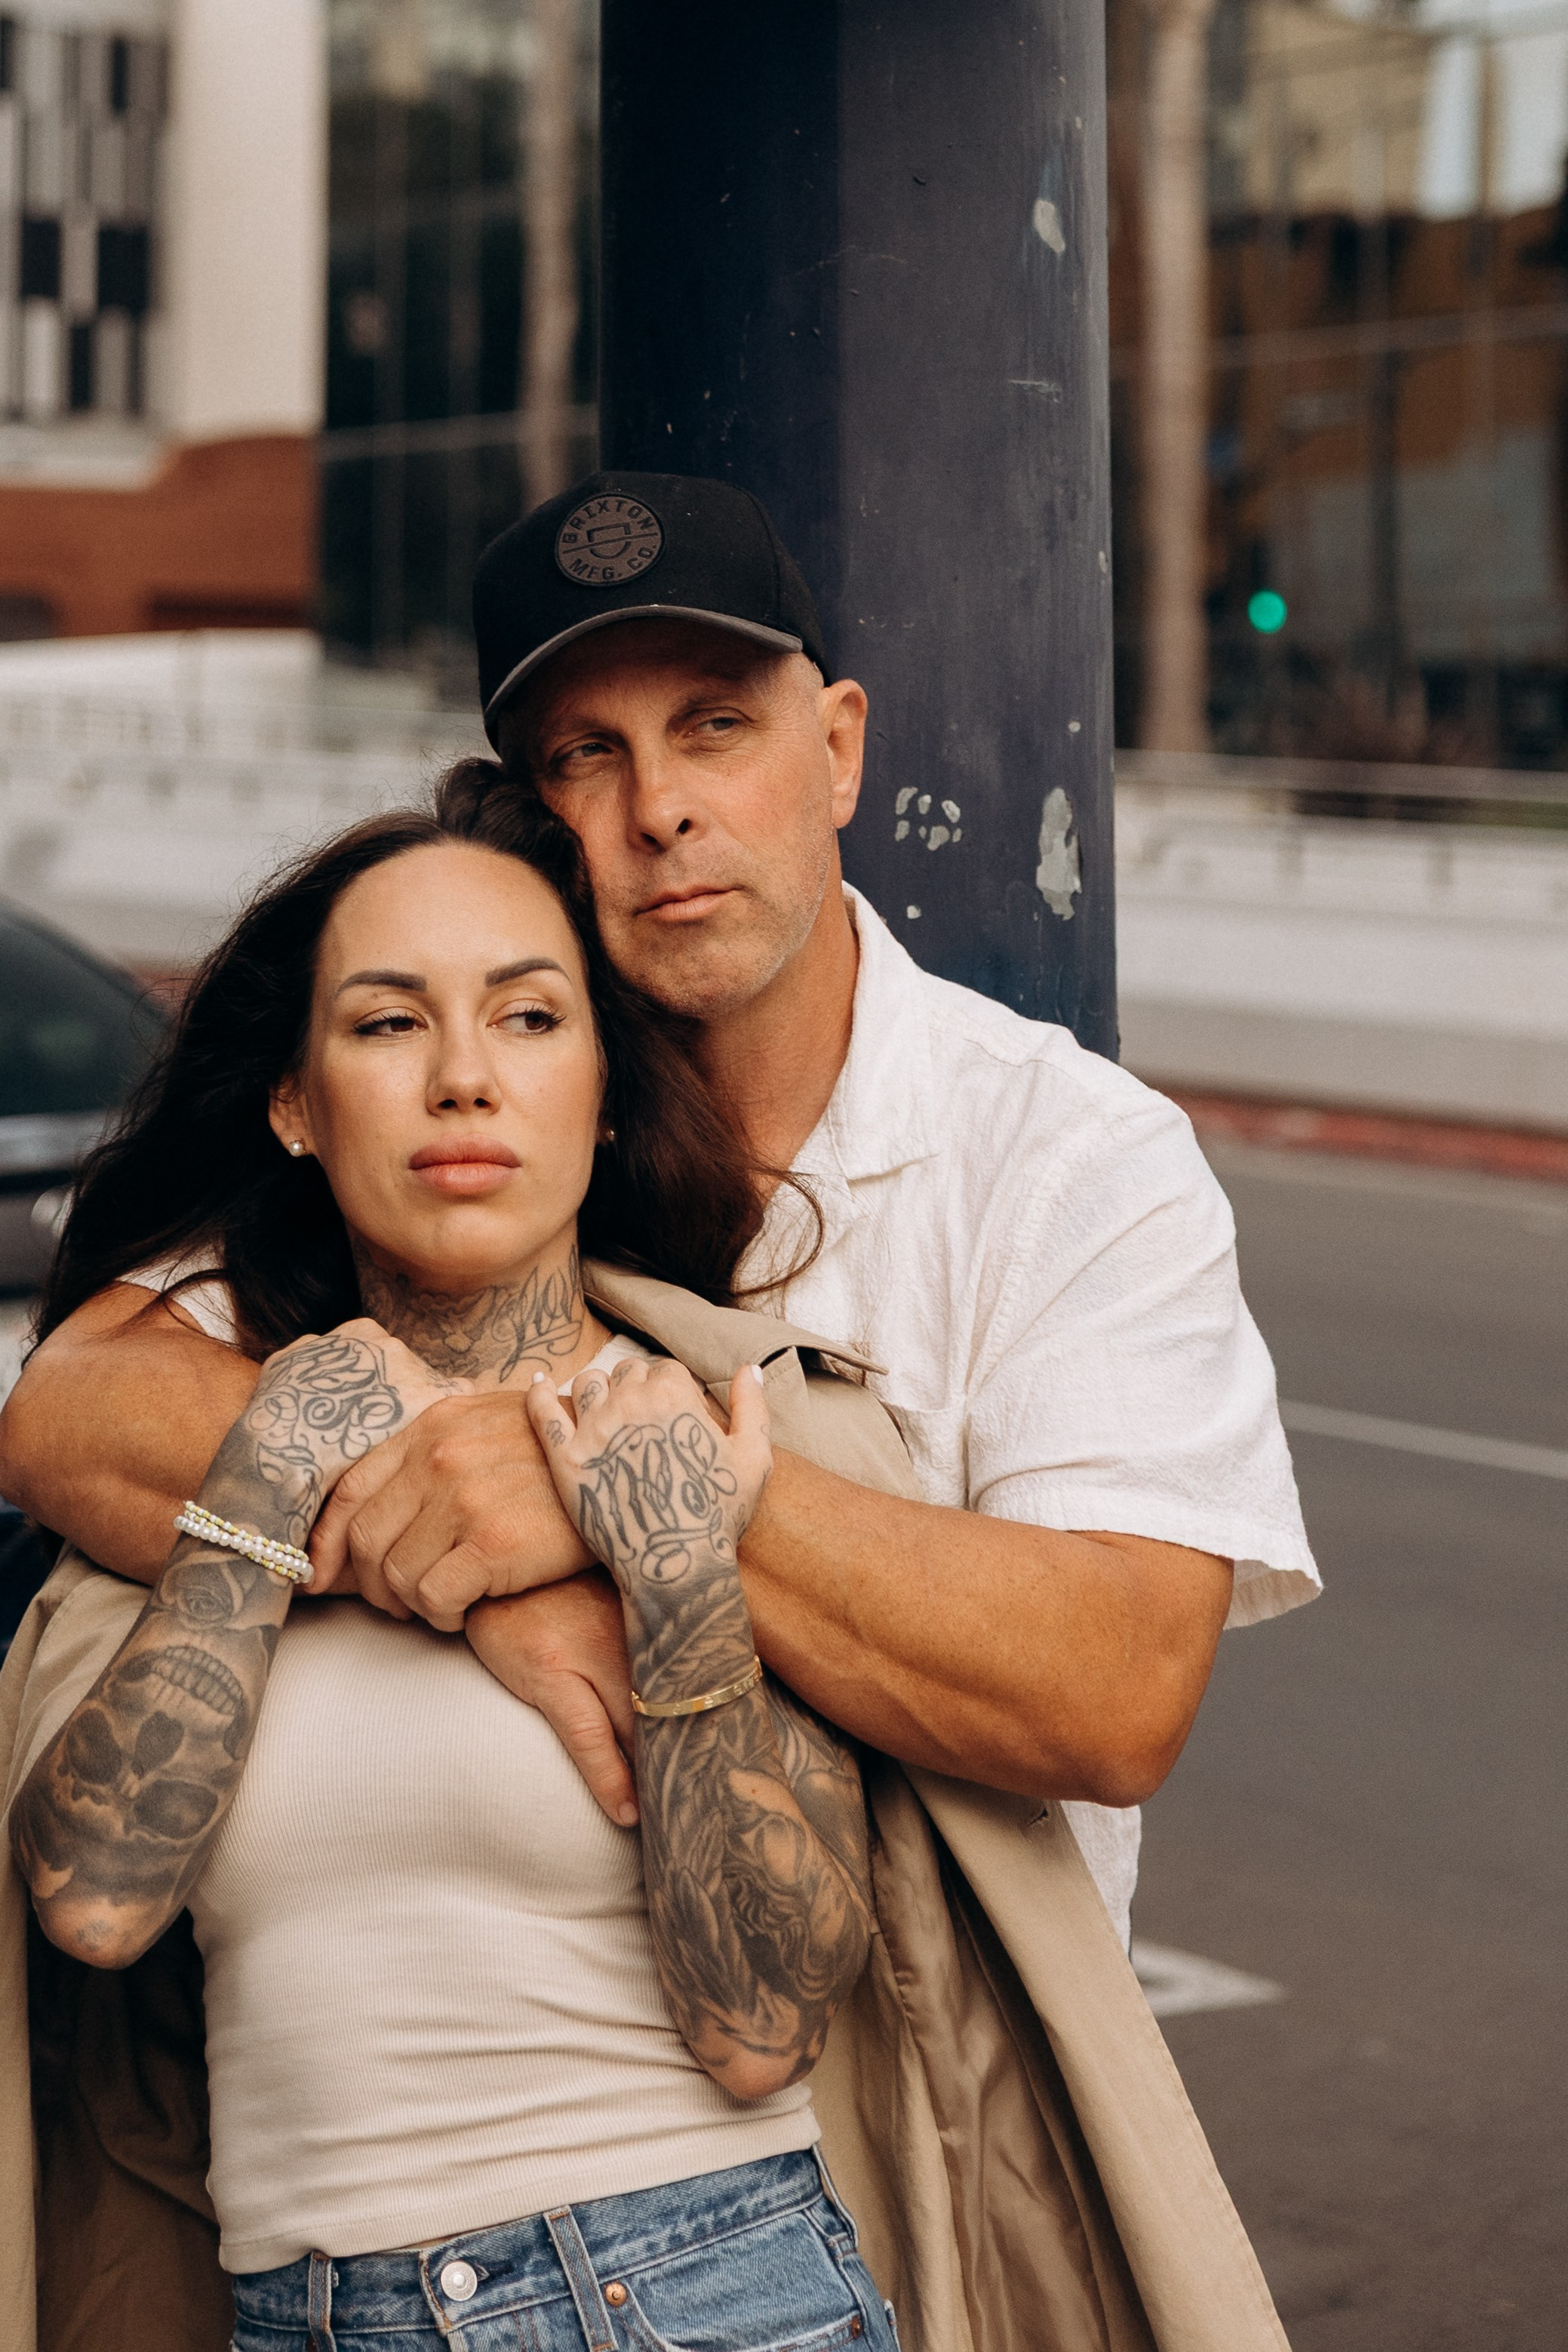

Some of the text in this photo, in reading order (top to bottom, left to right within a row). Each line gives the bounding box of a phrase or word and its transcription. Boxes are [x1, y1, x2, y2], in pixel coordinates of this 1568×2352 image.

[562, 500, 655, 543] BRIXTON
[569, 545, 656, 580] MFG. CO.
